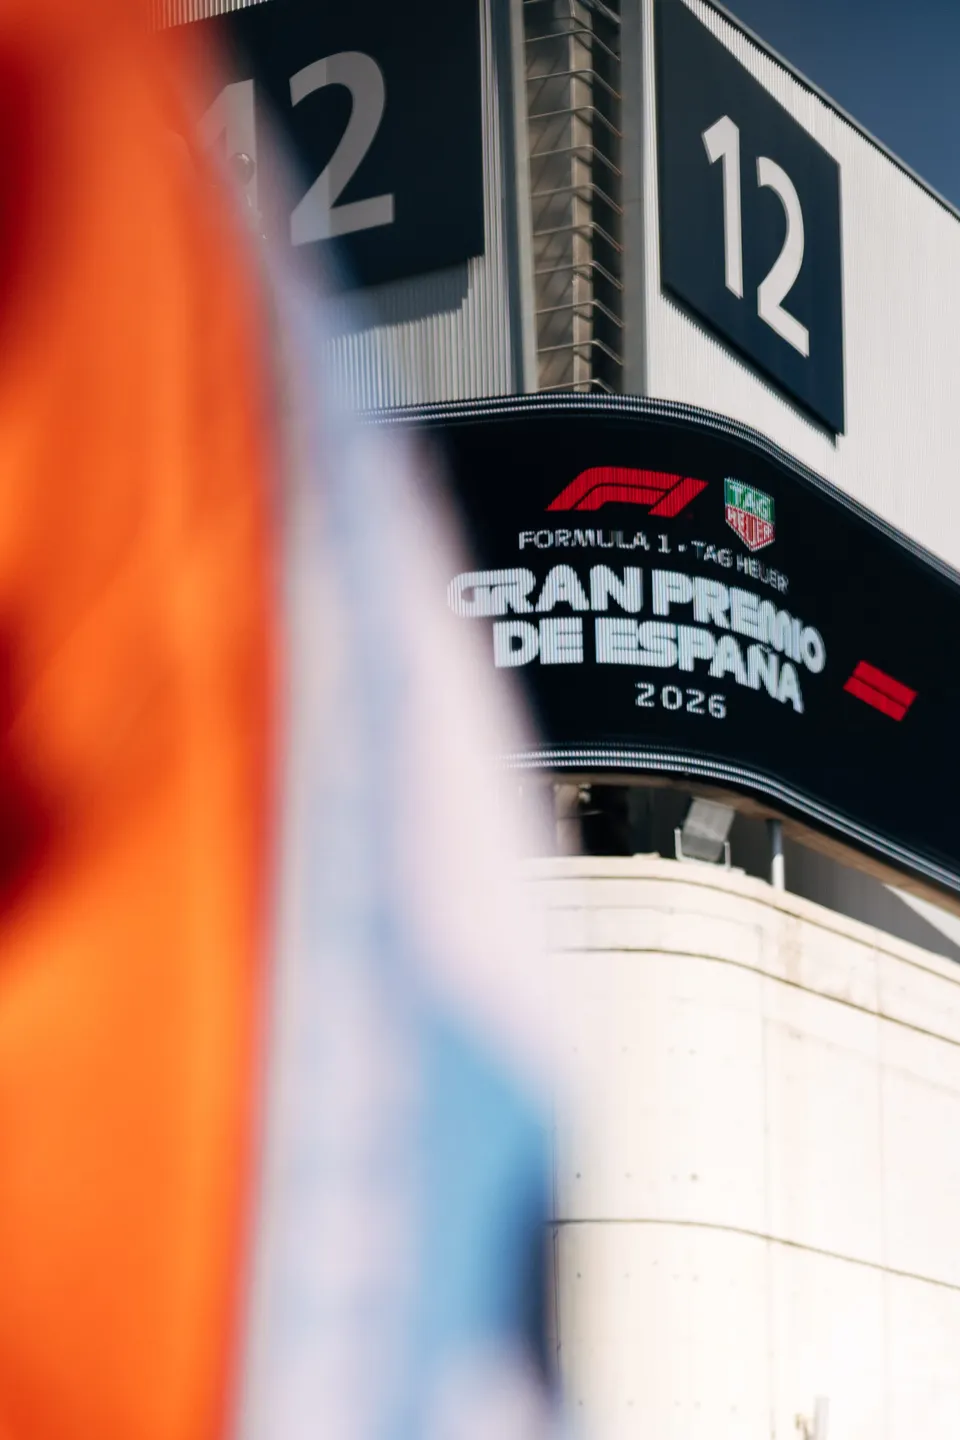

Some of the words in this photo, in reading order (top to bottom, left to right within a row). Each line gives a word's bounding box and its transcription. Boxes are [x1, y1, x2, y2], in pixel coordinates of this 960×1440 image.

[701, 115, 809, 356] 12
[729, 484, 774, 519] TAG
[518, 529, 648, 551] FORMULA
[656, 533, 670, 553] 1
[691, 540, 734, 570] TAG
[736, 555, 789, 595] HEUER
[447, 564, 643, 617] GRAN
[651, 568, 826, 675] PREMIO
[493, 617, 584, 668] DE
[595, 617, 805, 714] ESPAÑA
[634, 683, 727, 720] 2026
